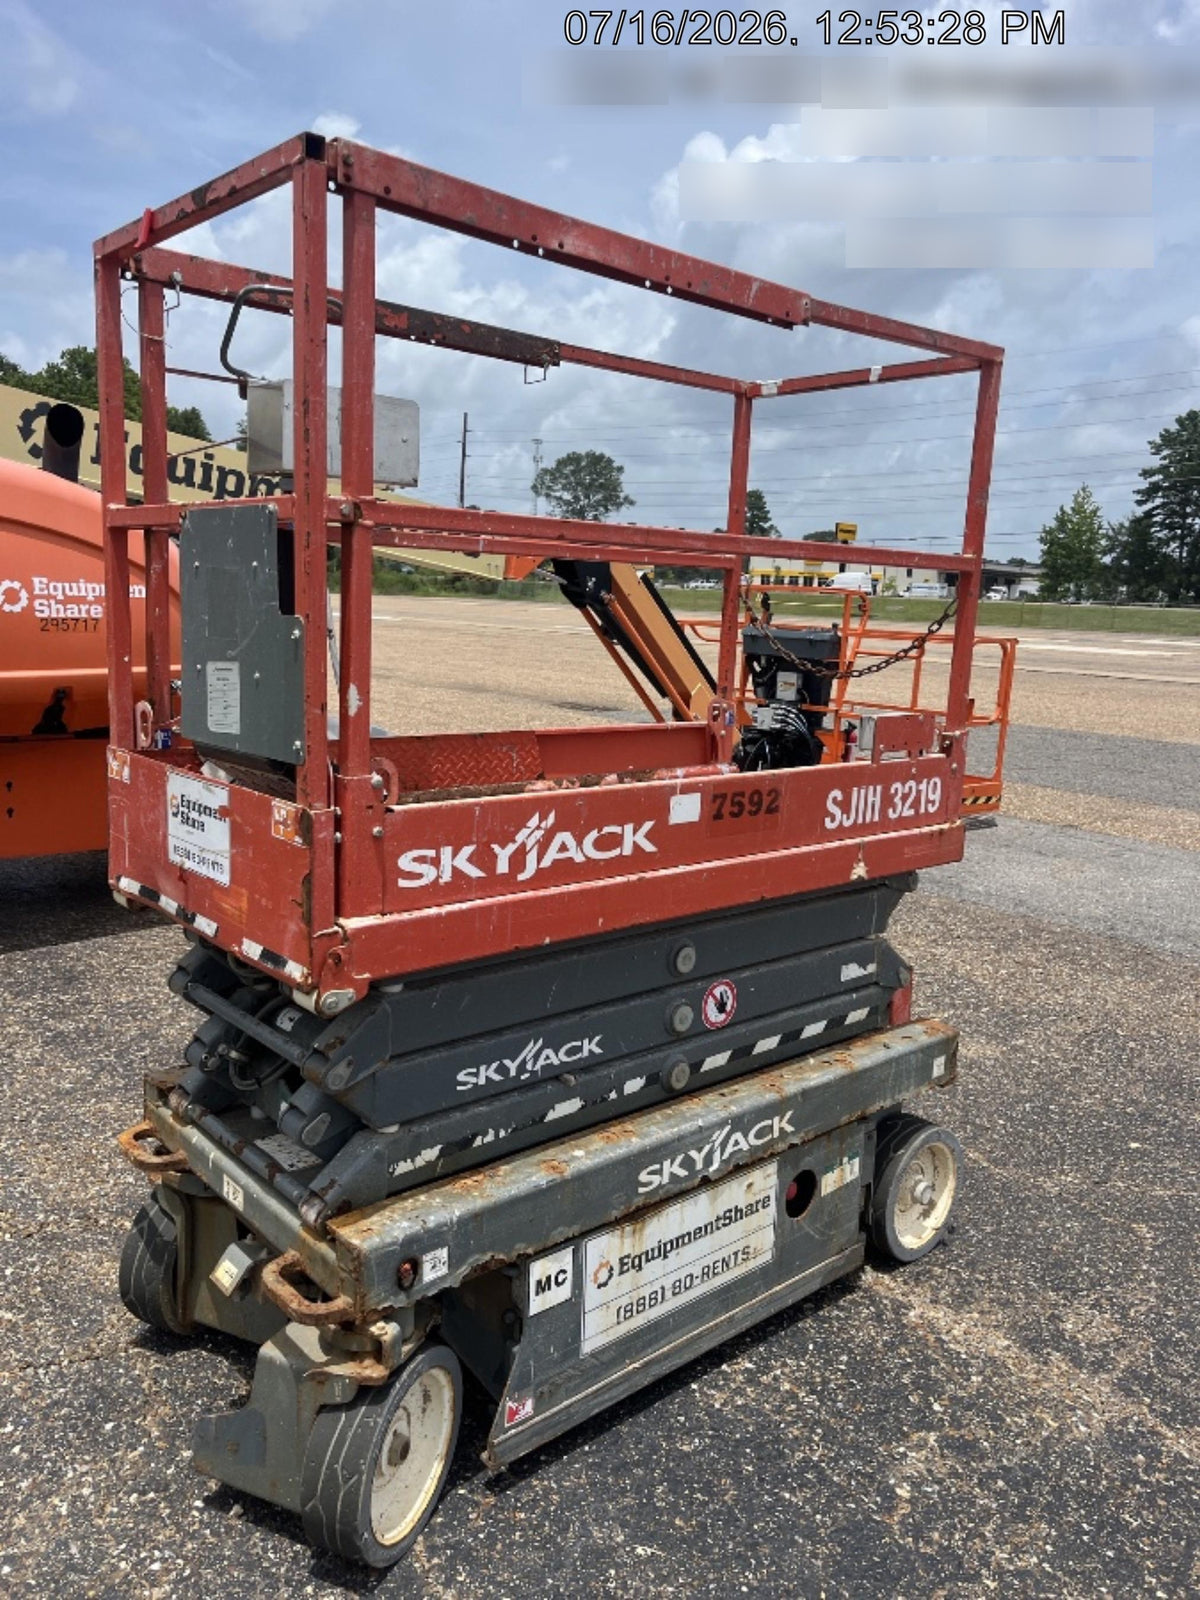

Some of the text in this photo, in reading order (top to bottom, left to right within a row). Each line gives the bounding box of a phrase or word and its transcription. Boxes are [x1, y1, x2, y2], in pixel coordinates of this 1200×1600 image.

[33, 599, 103, 618] Share
[711, 788, 781, 821] 7592
[887, 777, 942, 819] 3219
[397, 809, 658, 888] SKYJACK
[637, 1109, 796, 1194] SKYJACK
[618, 1194, 771, 1277] EquipmentShare
[535, 1269, 568, 1297] MC
[616, 1284, 665, 1325] (888)
